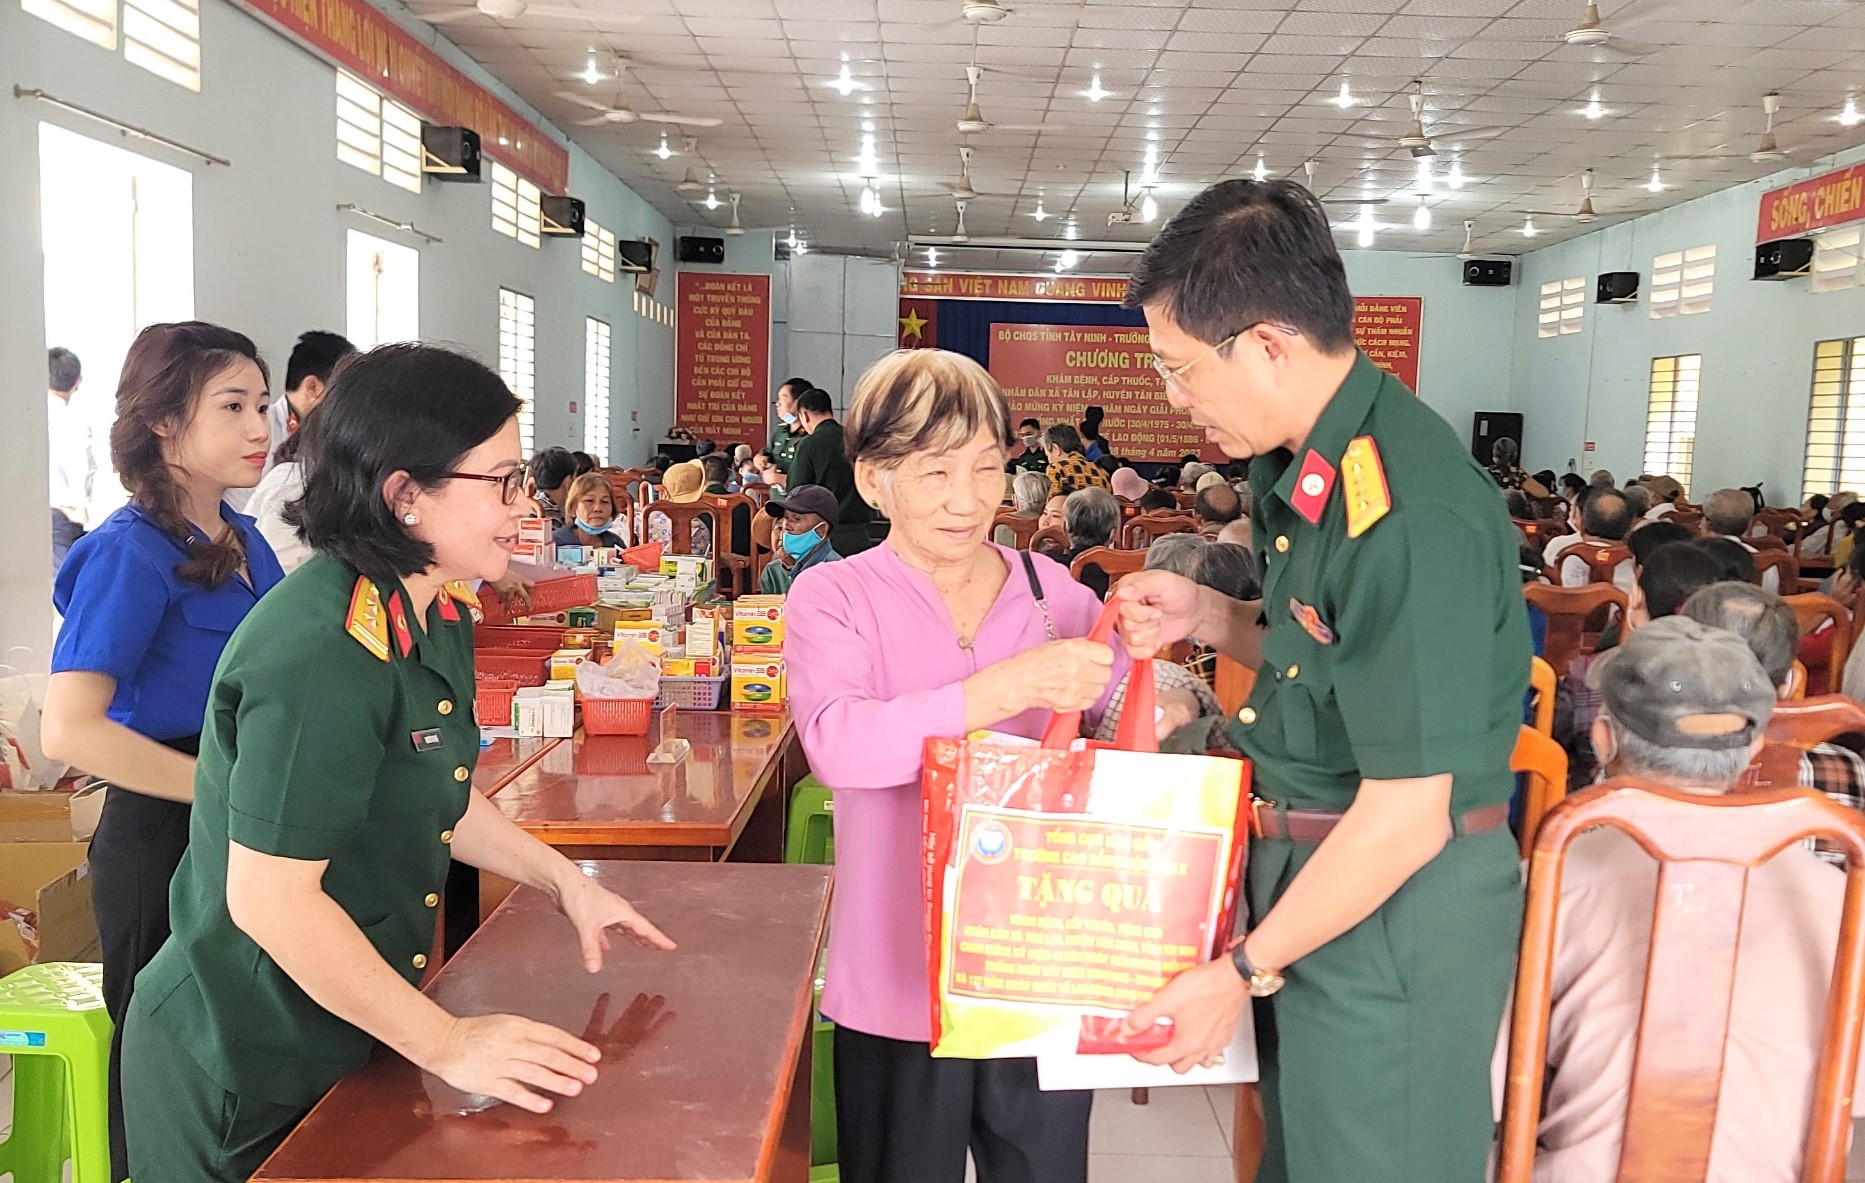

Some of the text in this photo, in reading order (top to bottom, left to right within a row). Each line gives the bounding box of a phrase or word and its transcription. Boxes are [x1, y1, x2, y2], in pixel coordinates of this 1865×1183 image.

[1770, 166, 1863, 231] SỐNG, CHIẾN
[959, 276, 992, 297] VIỆT
[997, 280, 1030, 296] NAM
[1092, 282, 1127, 298] VINH
[998, 329, 1011, 343] BỘ
[1013, 330, 1038, 341] CHQS
[1041, 328, 1061, 342] TỈNH
[1064, 331, 1082, 342] TÂY
[1084, 333, 1106, 343] NINH
[1114, 332, 1150, 344] TRƯỜNG
[1066, 348, 1130, 369] CHƯƠNG
[1046, 372, 1071, 384] KHÁM
[1102, 372, 1119, 385] CẤP
[1121, 374, 1153, 387] THUỐC,
[1028, 388, 1046, 398] DÂN
[1048, 387, 1060, 397] XÃ
[1063, 387, 1080, 398] TÂN
[1103, 390, 1132, 401] HUYỆN
[1135, 390, 1152, 400] TÂN
[1024, 401, 1049, 411] MỪNG
[1103, 403, 1122, 413] NĂM
[1124, 404, 1148, 414] NGÀY
[1150, 403, 1168, 414] GIẢI
[1112, 433, 1128, 442] LAO
[1131, 432, 1154, 445] ĐỘNG
[1121, 446, 1146, 458] tháng
[1148, 448, 1155, 456] 4
[1156, 447, 1176, 457] năm
[1016, 871, 1095, 908] TẶNG
